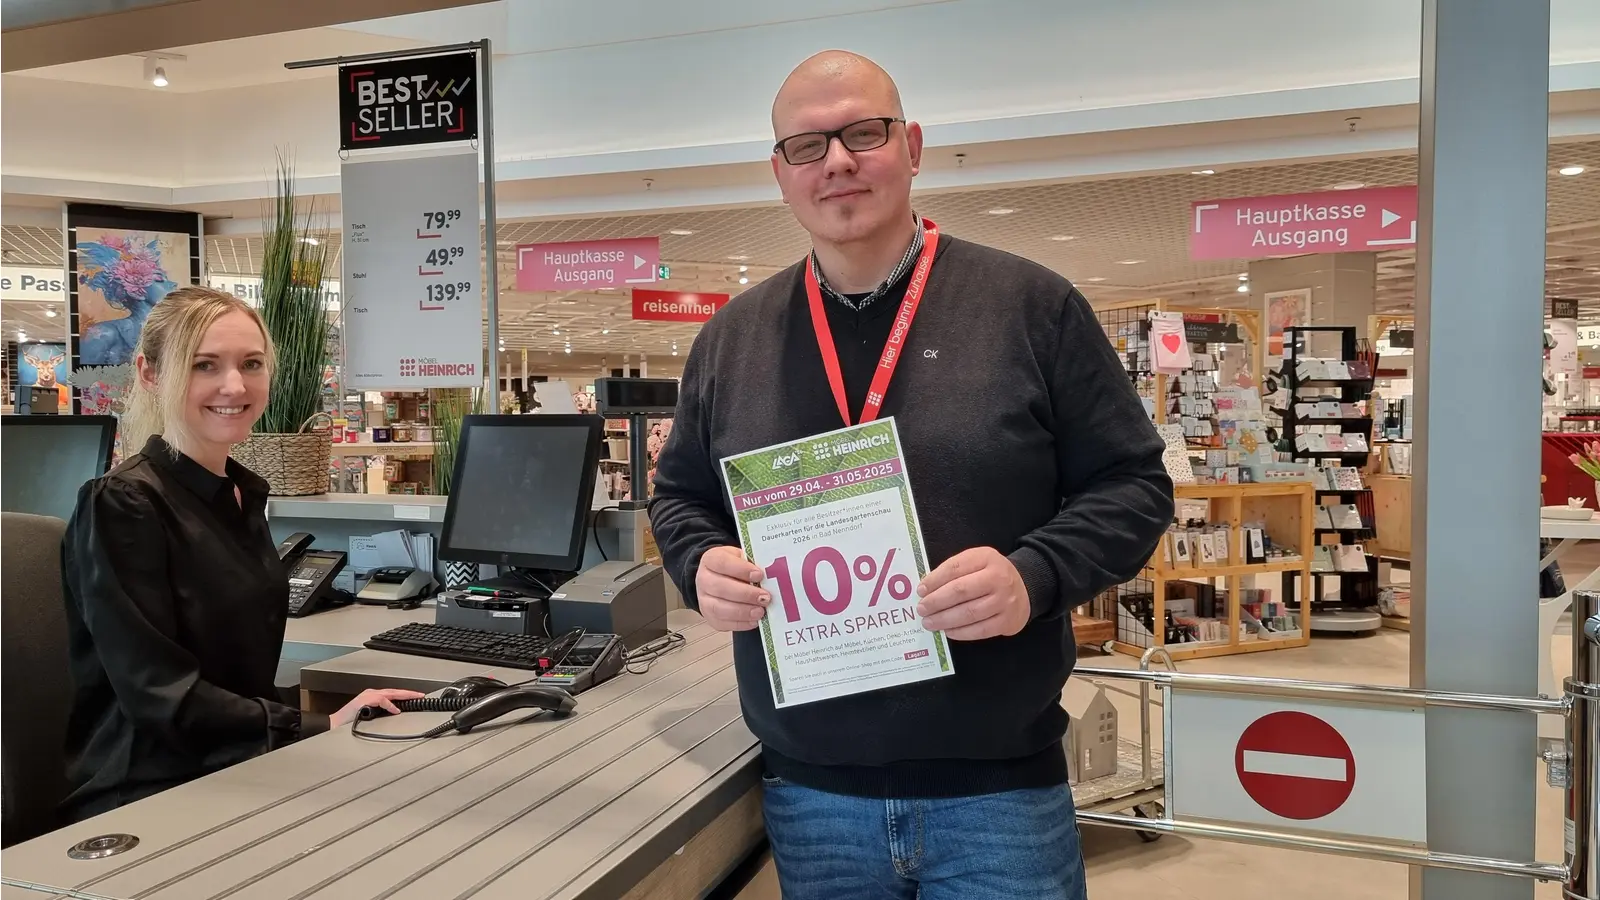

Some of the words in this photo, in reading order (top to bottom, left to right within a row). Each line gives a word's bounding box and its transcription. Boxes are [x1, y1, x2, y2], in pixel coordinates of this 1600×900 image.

[358, 74, 428, 106] BEST
[358, 100, 454, 134] SELLER
[423, 209, 461, 230] 79.99
[1236, 203, 1366, 227] Hauptkasse
[1252, 227, 1348, 249] Ausgang
[425, 246, 464, 266] 49.99
[543, 249, 625, 267] Hauptkasse
[554, 267, 614, 285] Ausgang
[426, 282, 471, 302] 139.99
[880, 345, 896, 369] Hier
[889, 300, 914, 344] beginnt
[905, 255, 930, 300] Zuhause.
[923, 349, 939, 359] CK
[418, 363, 475, 377] HEINRICH
[832, 433, 890, 457] HEINRICH
[742, 496, 761, 507] Nur
[764, 490, 787, 502] vom
[789, 480, 824, 497] 29.04.
[832, 462, 893, 486] 31.05.2025
[761, 528, 803, 542] Dauerkarten
[803, 523, 814, 532] für
[814, 521, 825, 529] die
[826, 507, 892, 527] Landesgartenschau
[766, 521, 792, 532] Exklusiv
[793, 518, 803, 526] für
[804, 514, 816, 523] alle
[865, 499, 882, 509] einer
[792, 535, 811, 544] 2026
[818, 529, 832, 539] Bad
[832, 522, 863, 535] Nenndorf
[765, 546, 912, 623] 10%
[784, 622, 841, 646] EXTRA
[843, 605, 916, 634] SPAREN
[793, 650, 811, 659] Möbel
[811, 645, 834, 655] Heinrich
[834, 643, 844, 651] auf
[844, 639, 863, 648] Möbel,
[863, 635, 887, 645] Küchen,
[795, 653, 840, 666] Haushaltswaren,
[840, 645, 877, 657] Heimtextilien
[877, 642, 889, 650] und
[889, 637, 916, 648] Leuchten
